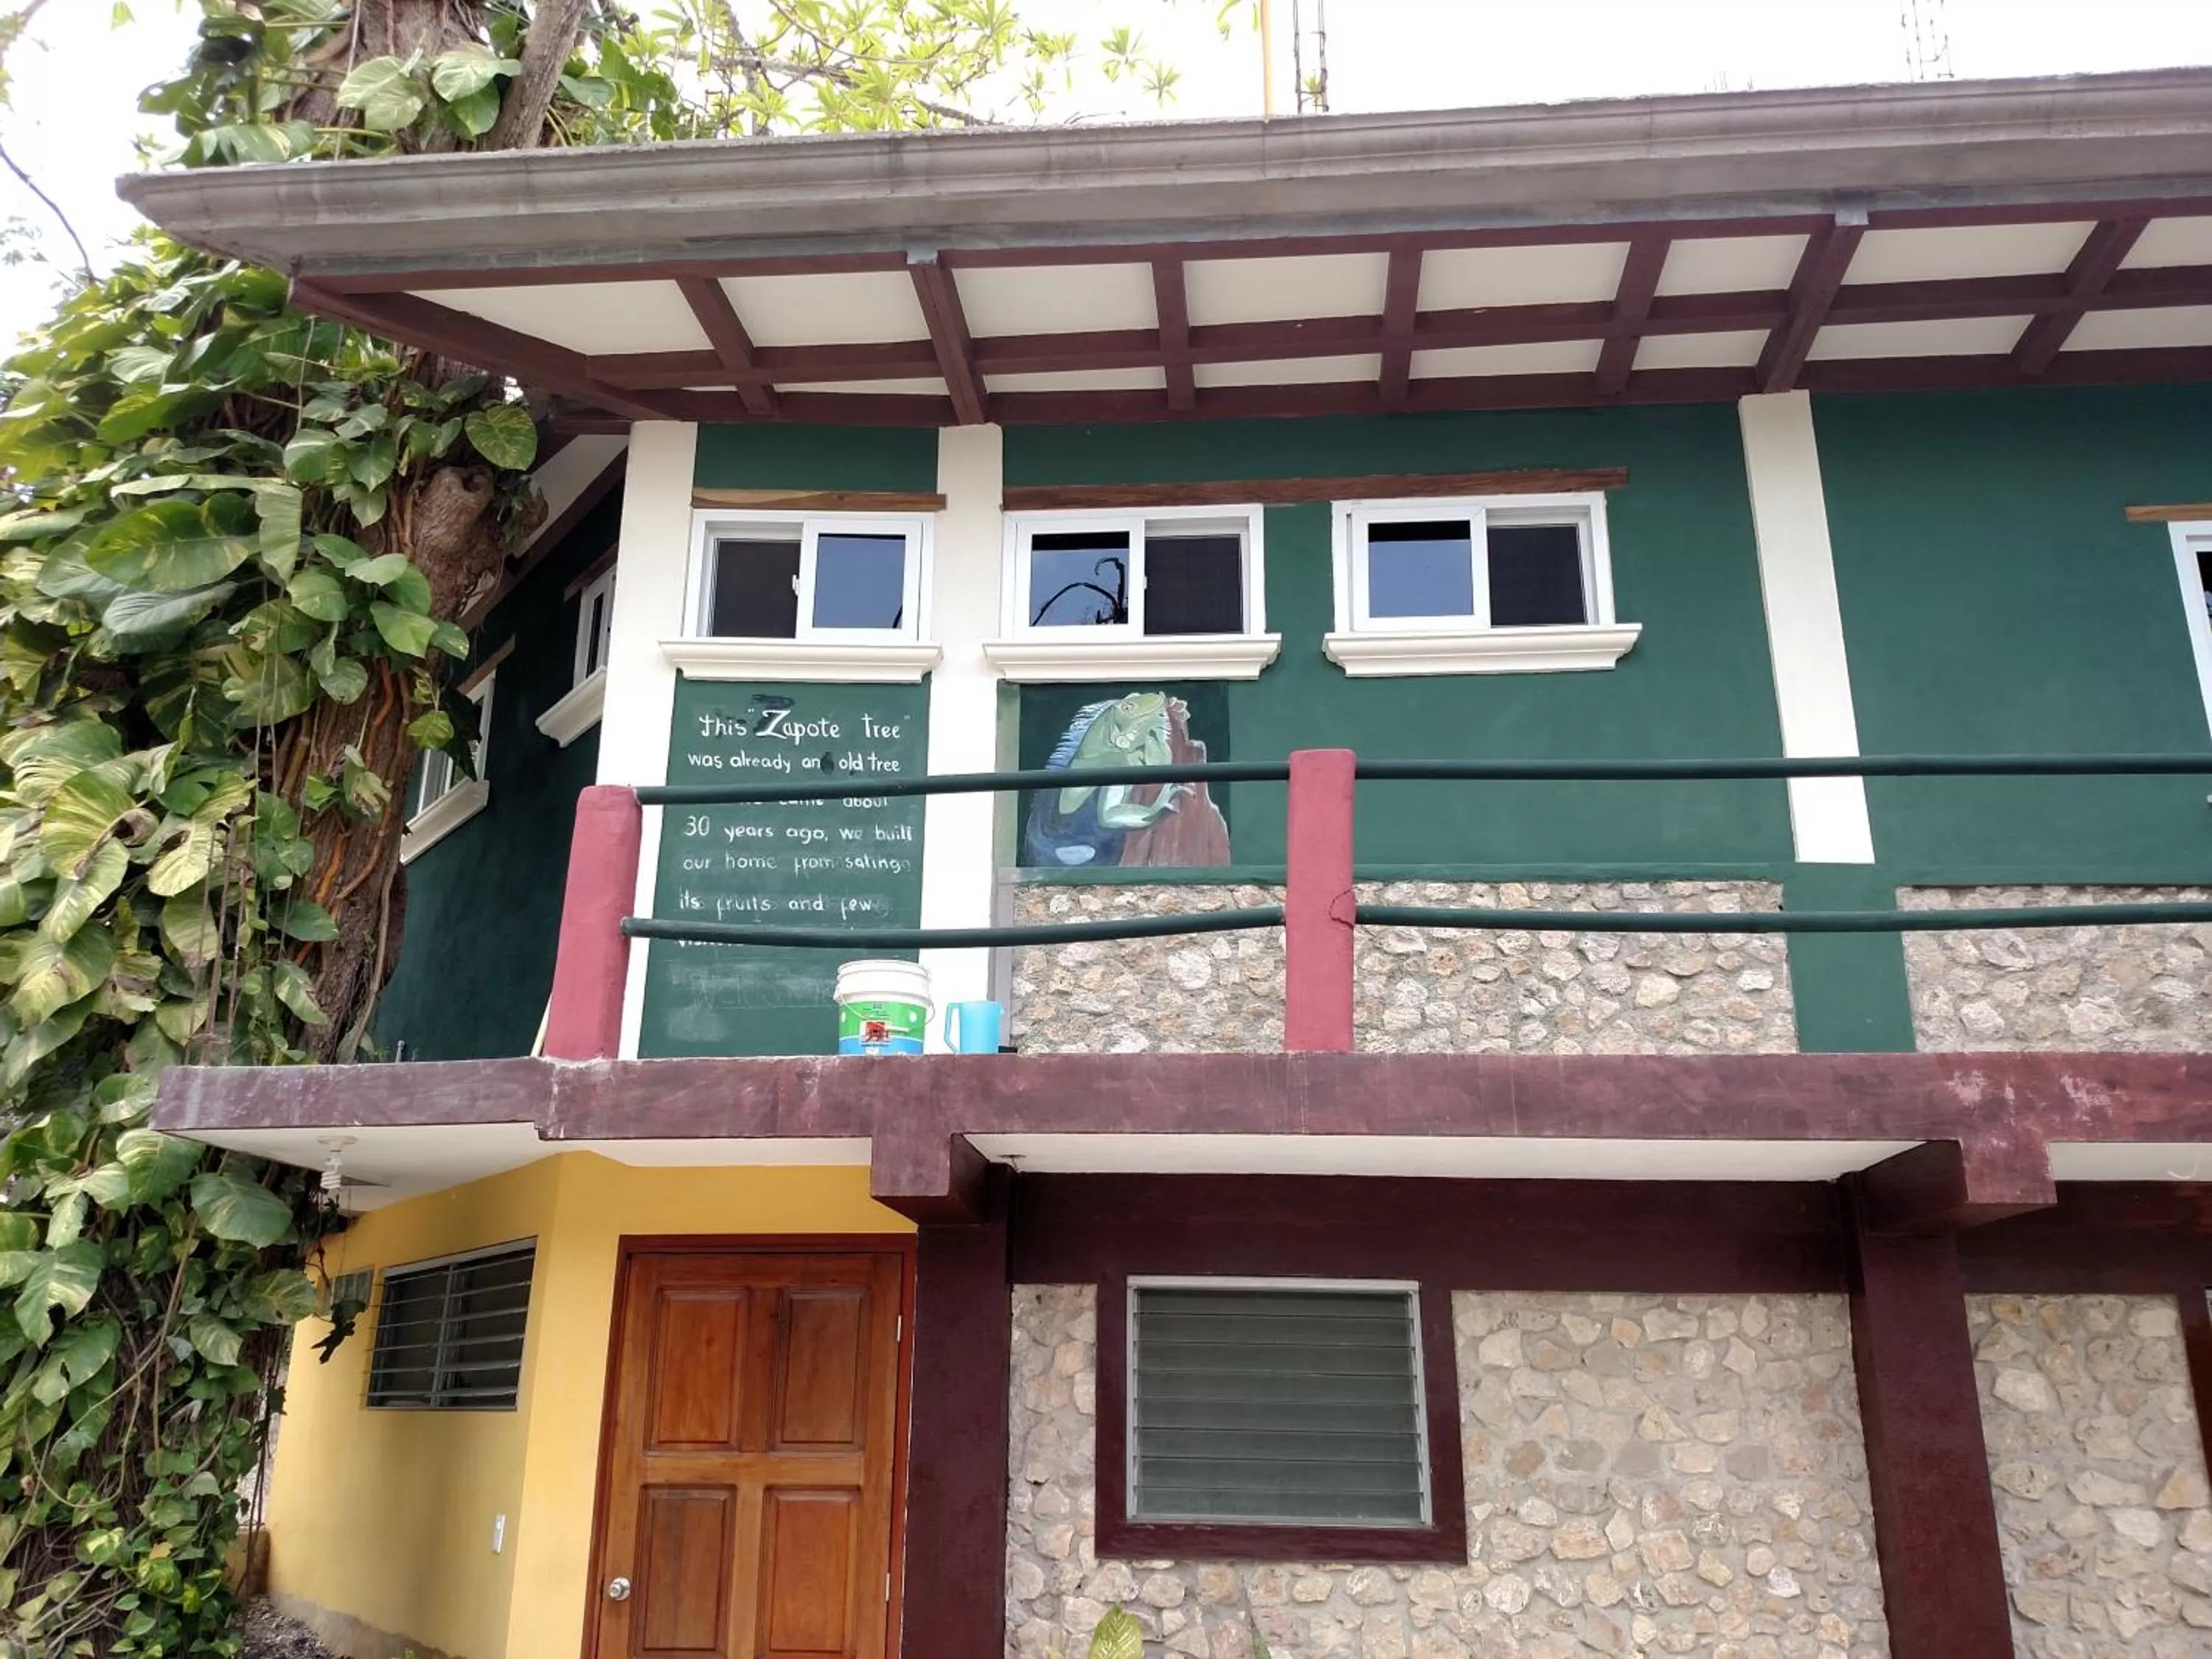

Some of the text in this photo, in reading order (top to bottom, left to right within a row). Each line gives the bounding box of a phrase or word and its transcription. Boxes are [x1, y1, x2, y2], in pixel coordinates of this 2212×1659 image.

[687, 748, 900, 773] was already an old tree
[684, 815, 915, 844] 30 years ago, we built
[684, 858, 712, 871] our
[725, 850, 778, 869] home
[679, 889, 700, 909] its
[788, 893, 824, 911] and
